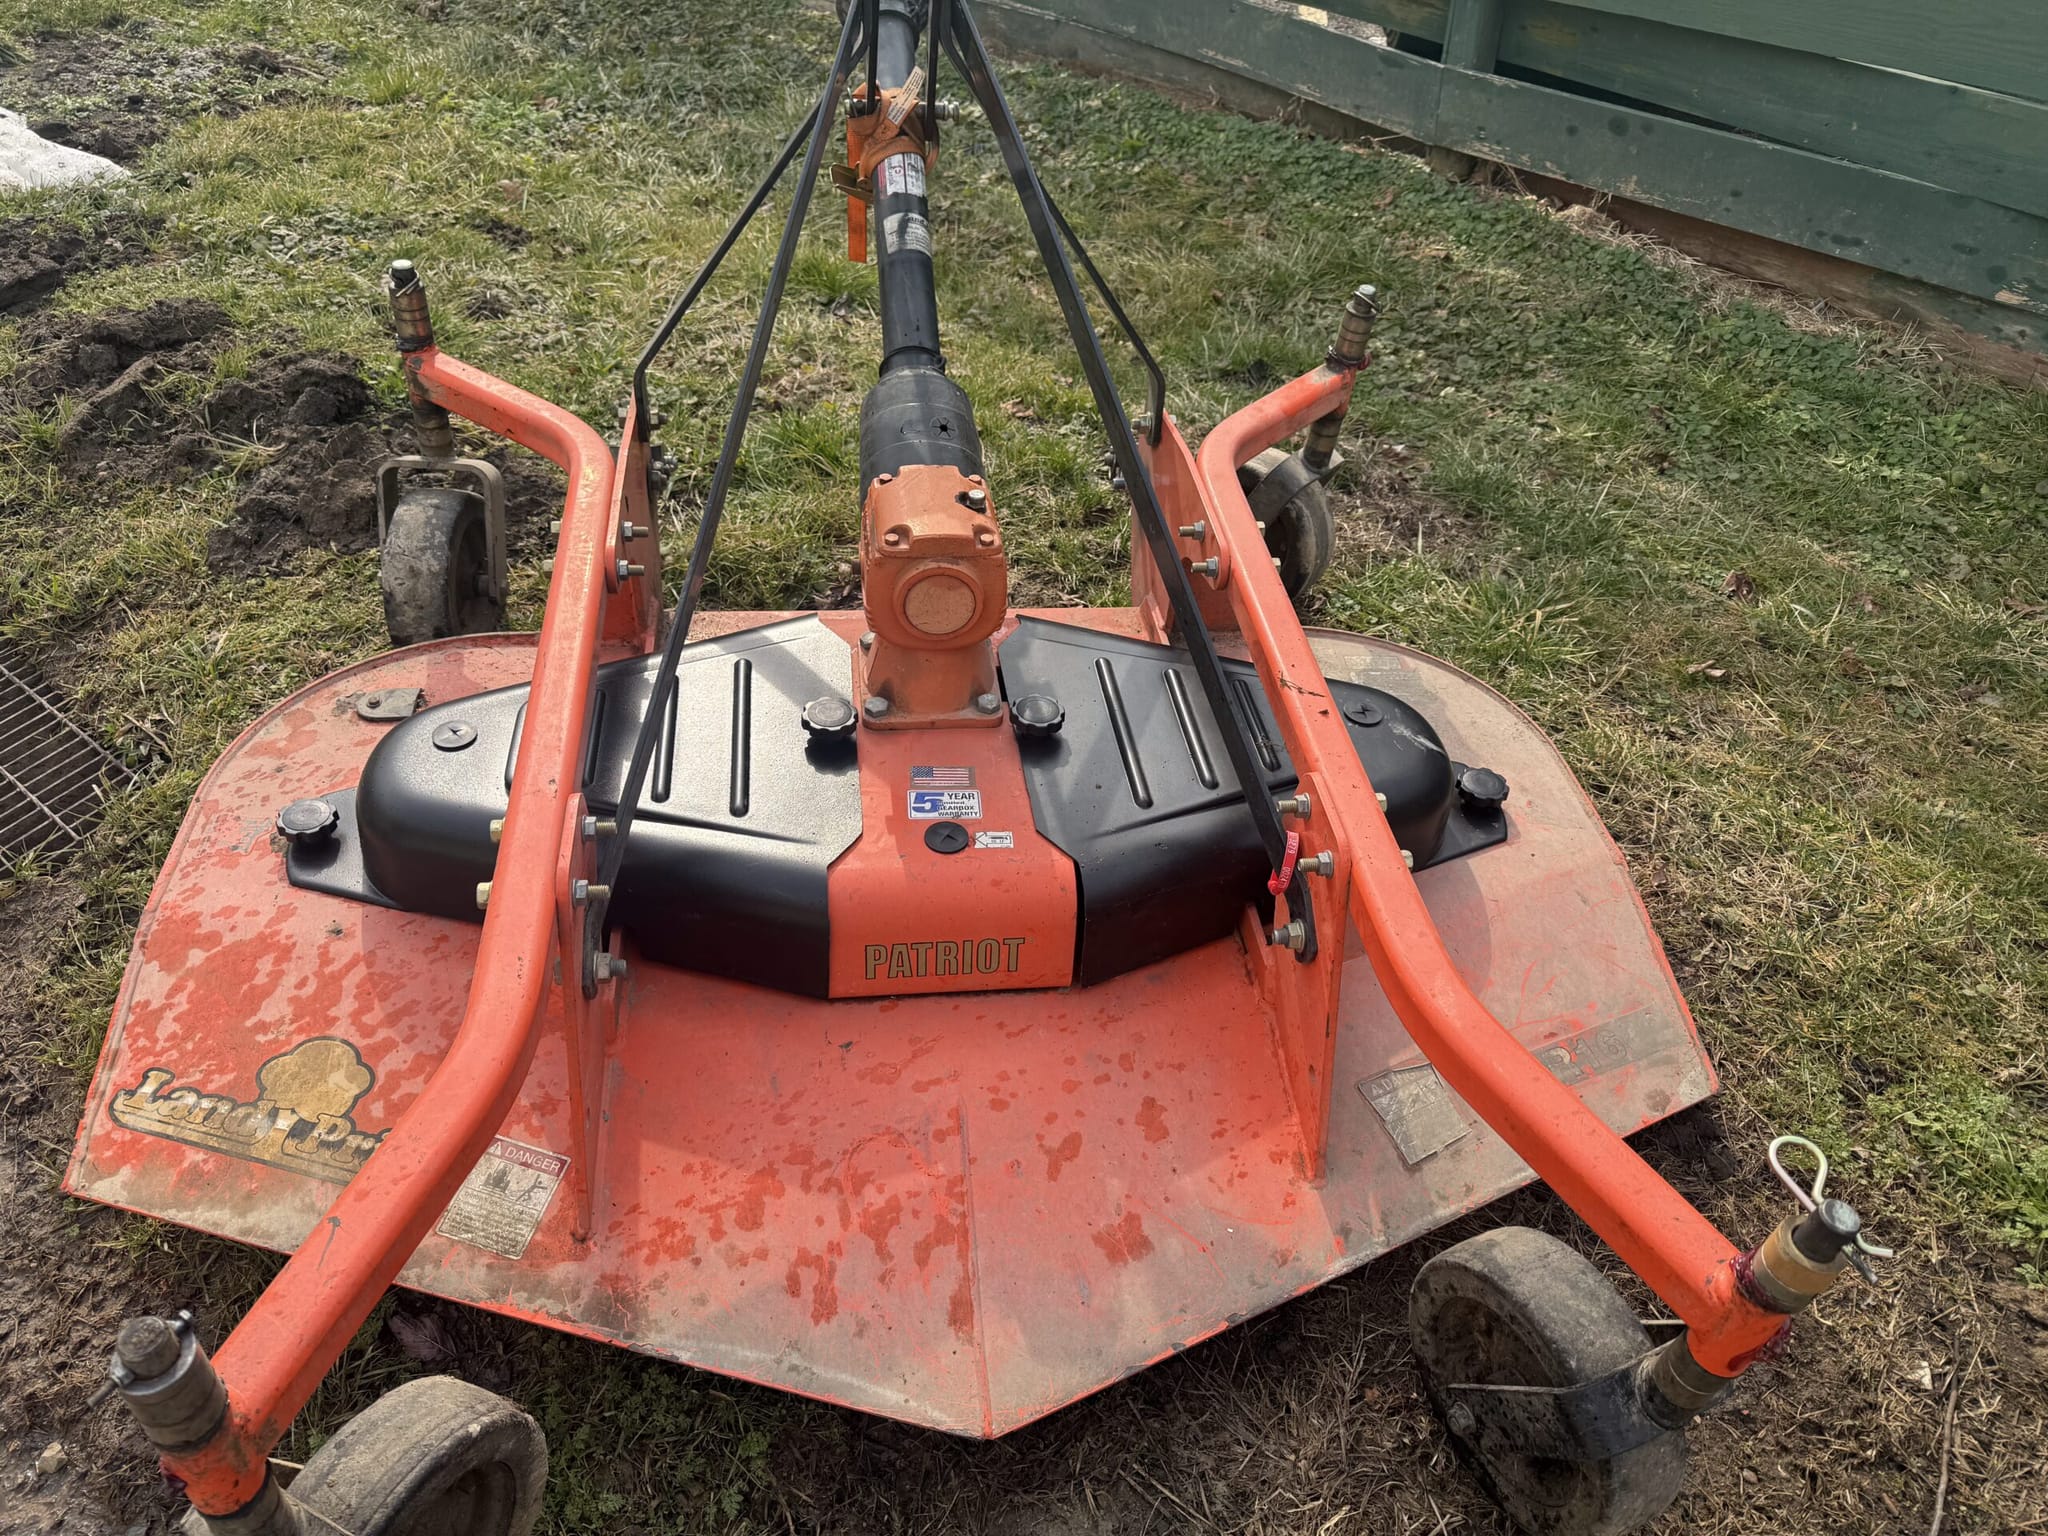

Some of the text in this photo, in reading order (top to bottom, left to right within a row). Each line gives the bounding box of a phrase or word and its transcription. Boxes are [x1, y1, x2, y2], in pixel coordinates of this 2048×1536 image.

[912, 792, 975, 813] 5 YEAR
[865, 937, 1026, 980] PATRIOT
[121, 1069, 277, 1138] Land
[505, 1146, 562, 1173] DANGER
